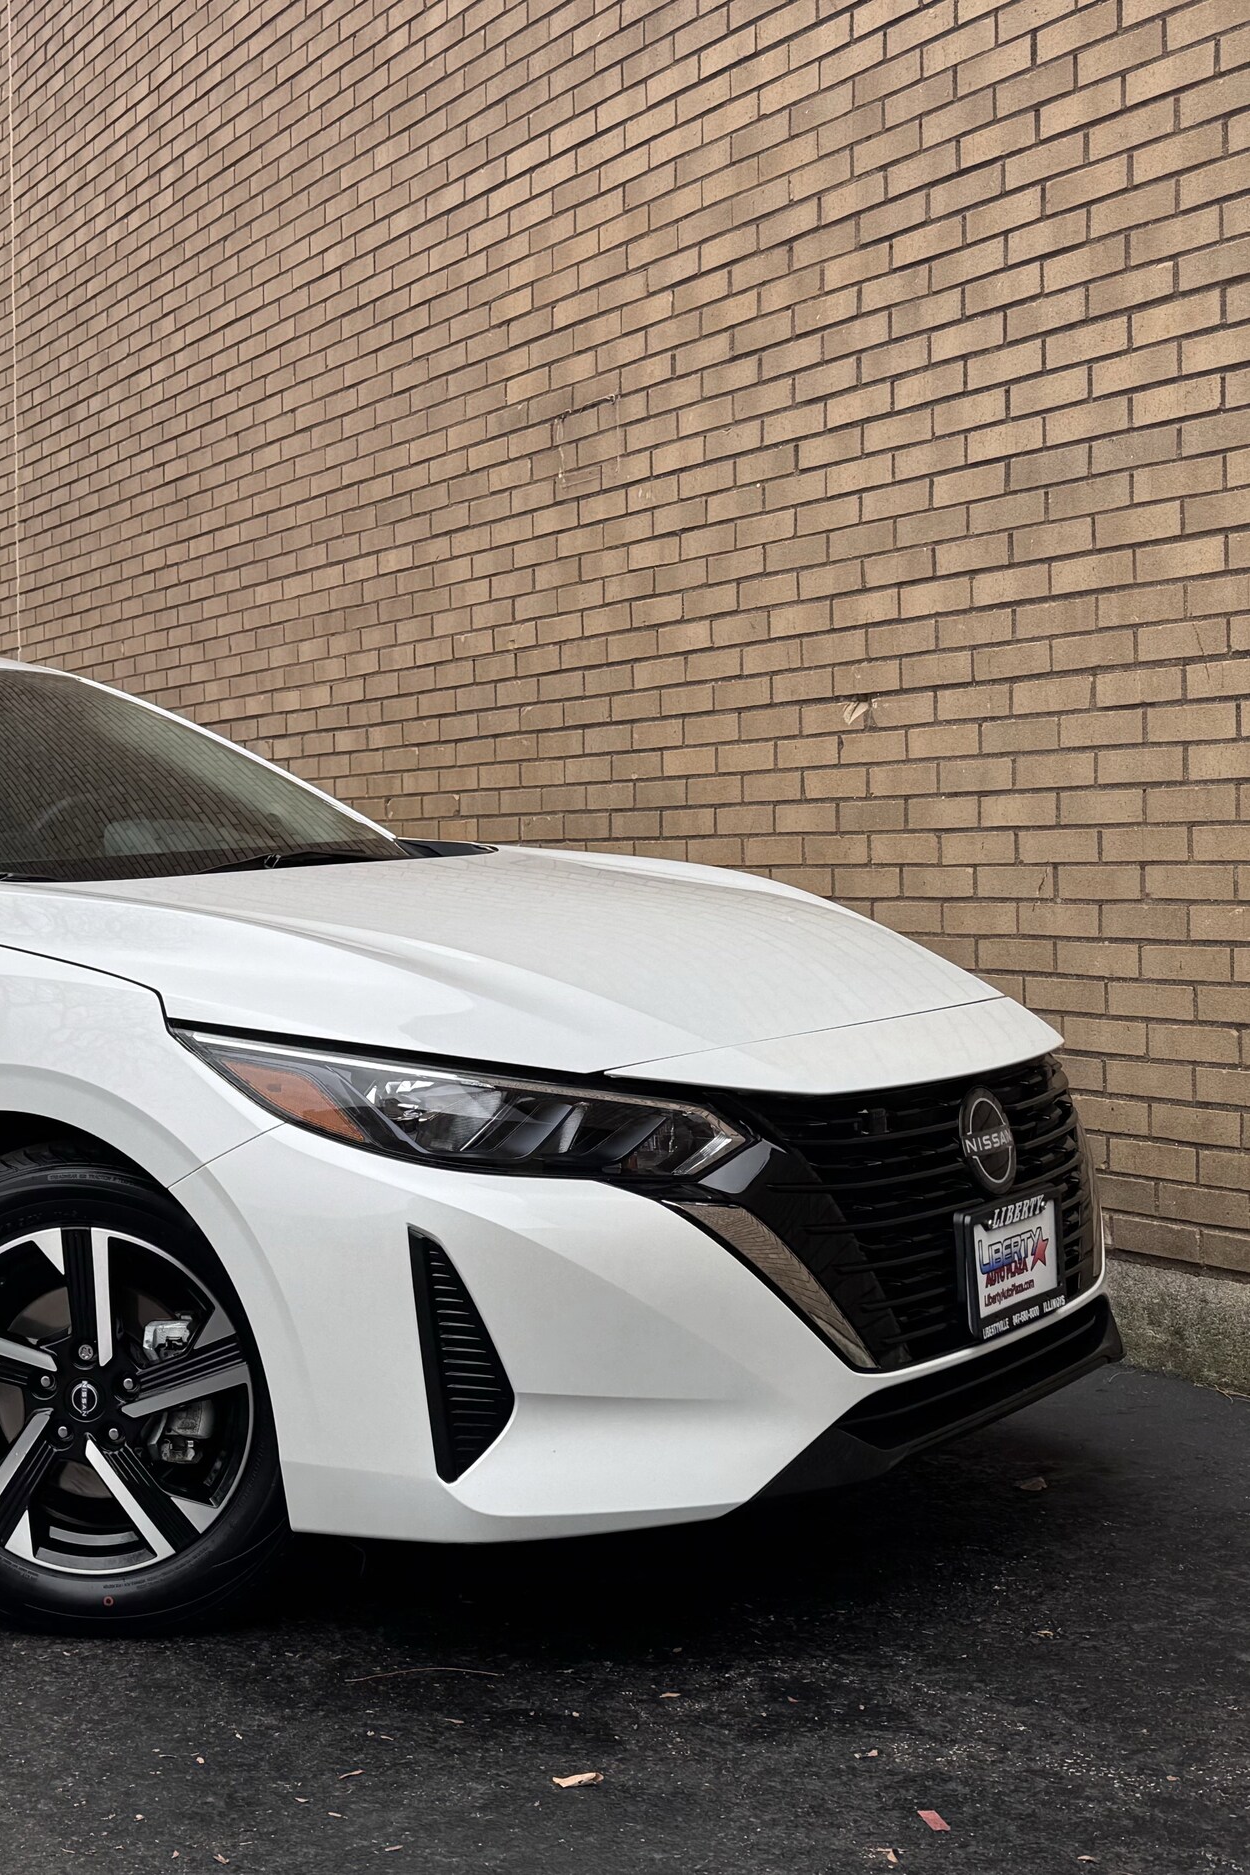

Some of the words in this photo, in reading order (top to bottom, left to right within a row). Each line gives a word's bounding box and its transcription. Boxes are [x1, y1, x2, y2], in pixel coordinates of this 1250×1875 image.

[965, 1129, 1012, 1153] NISSAN
[992, 1194, 1044, 1229] LIBERTY
[978, 1227, 1043, 1274] LIBERTY
[985, 1266, 1005, 1288] AUTO
[1006, 1258, 1028, 1281] PLAZA
